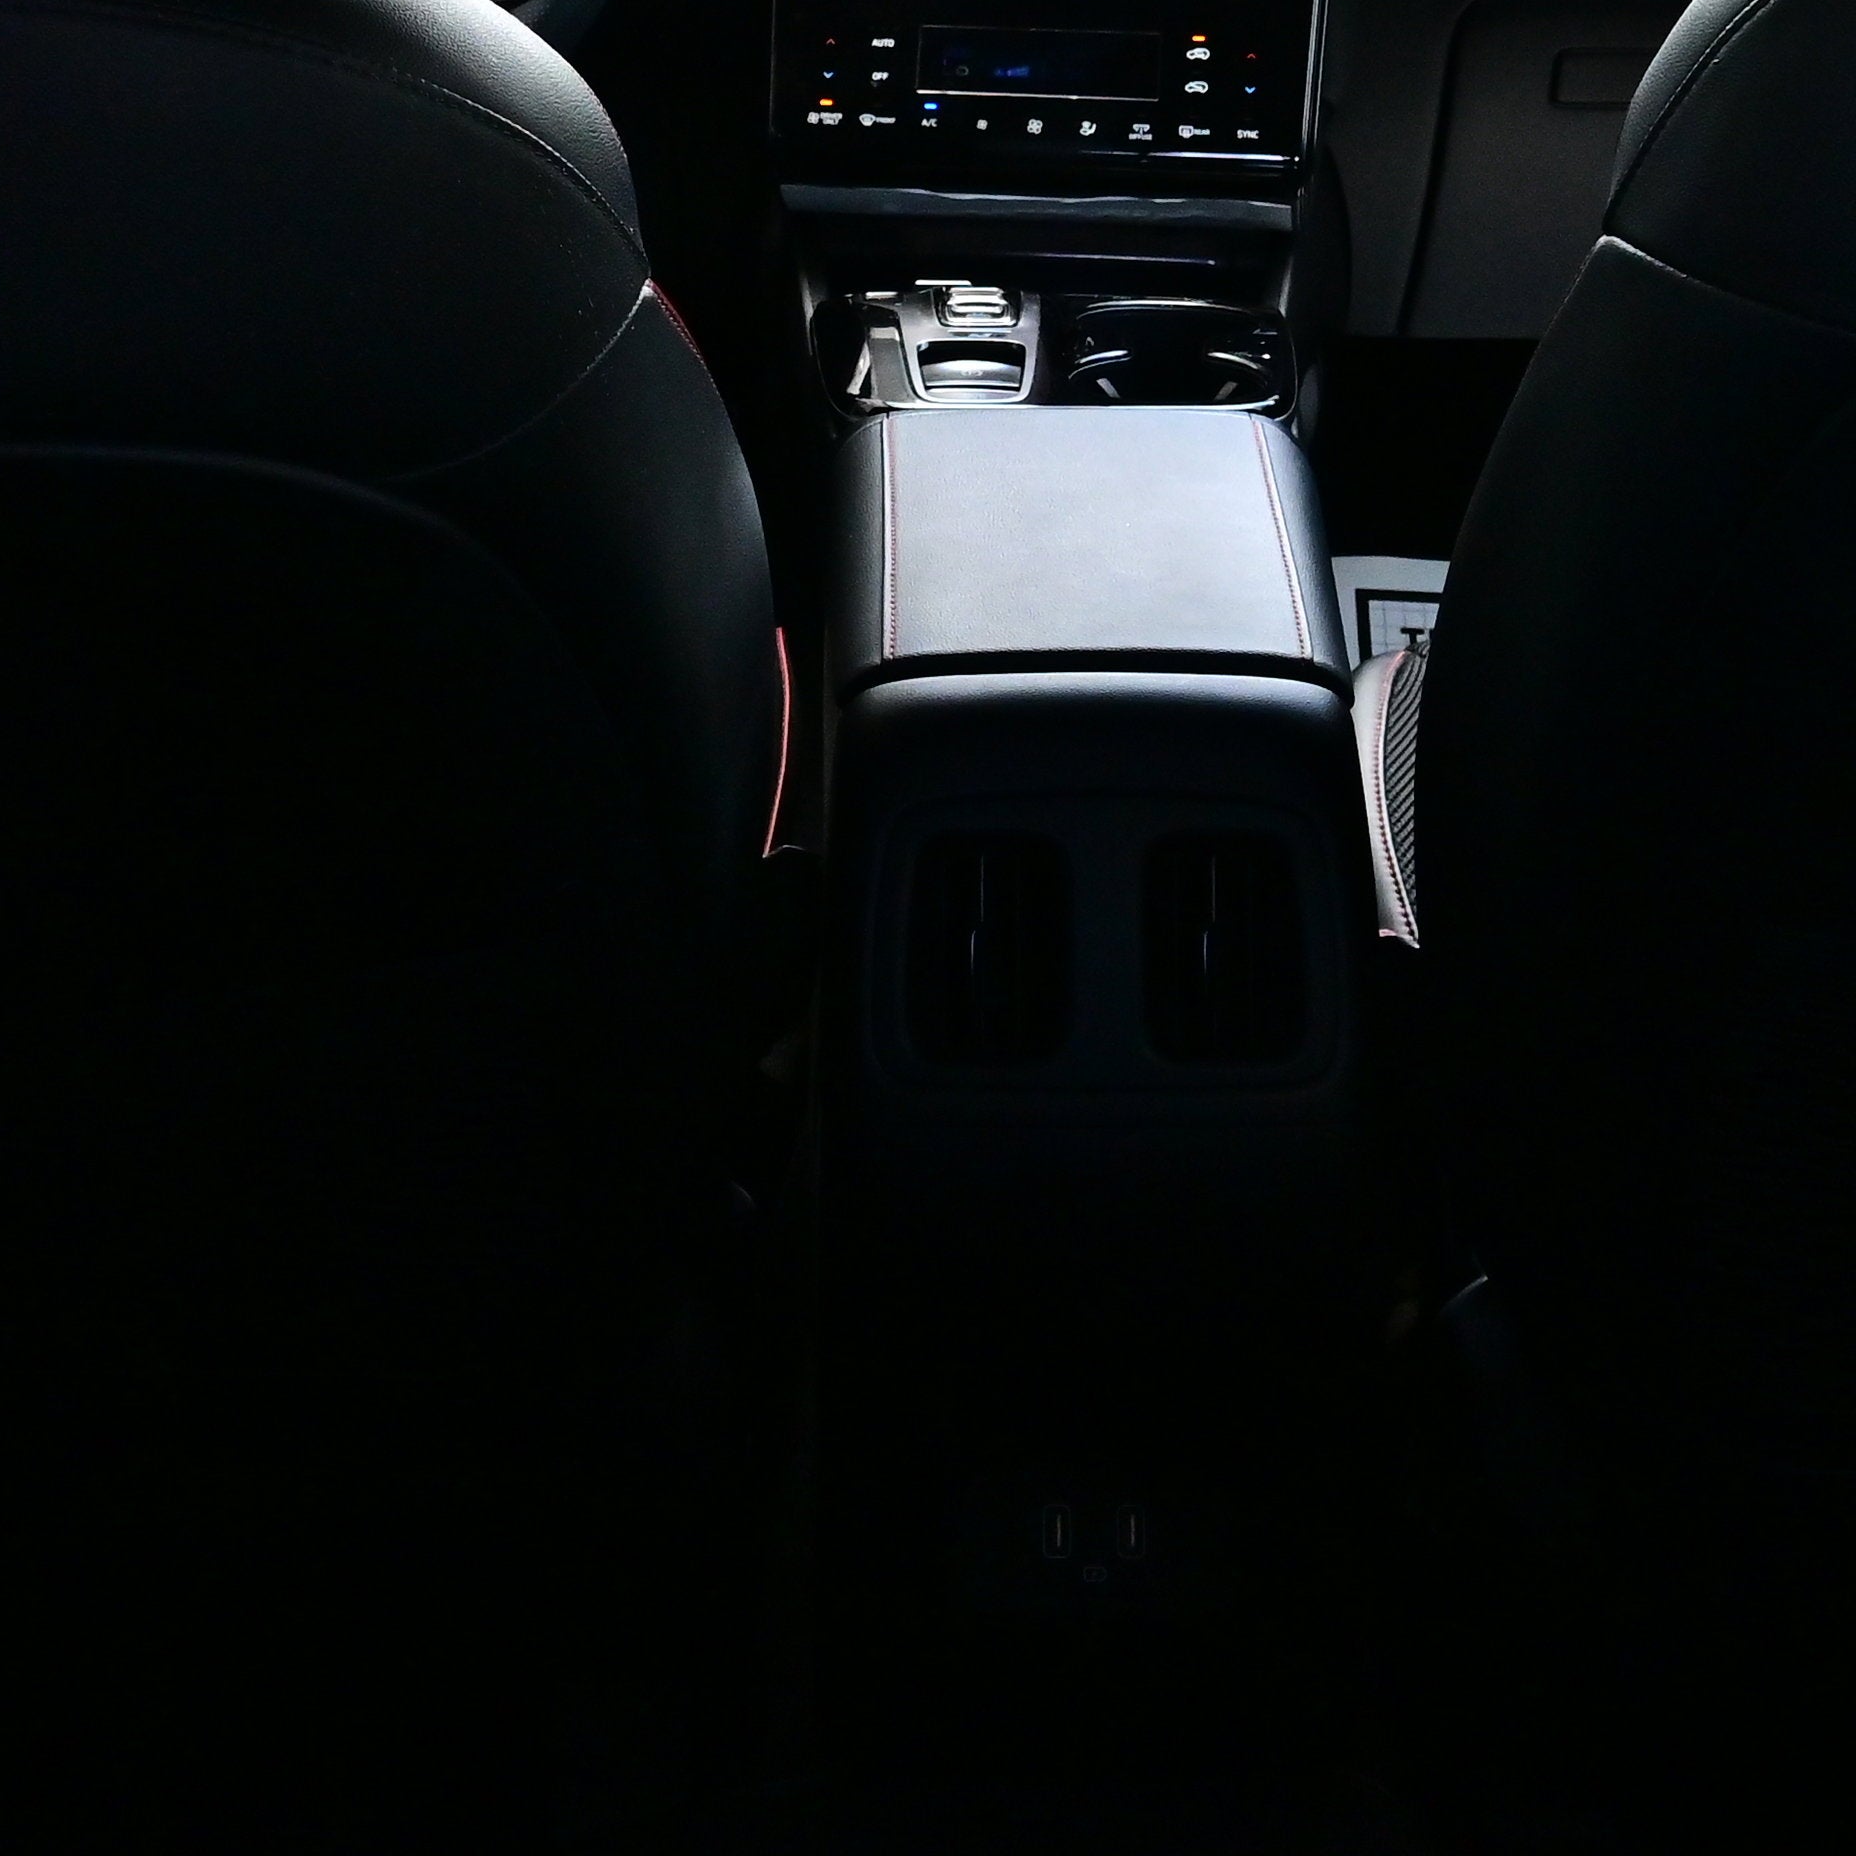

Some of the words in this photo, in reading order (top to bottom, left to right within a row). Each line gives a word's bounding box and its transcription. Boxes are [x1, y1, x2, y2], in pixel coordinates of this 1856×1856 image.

[871, 37, 896, 48] AUTO
[871, 71, 889, 81] OFF
[920, 118, 938, 128] A/C
[1236, 129, 1260, 140] SYNC
